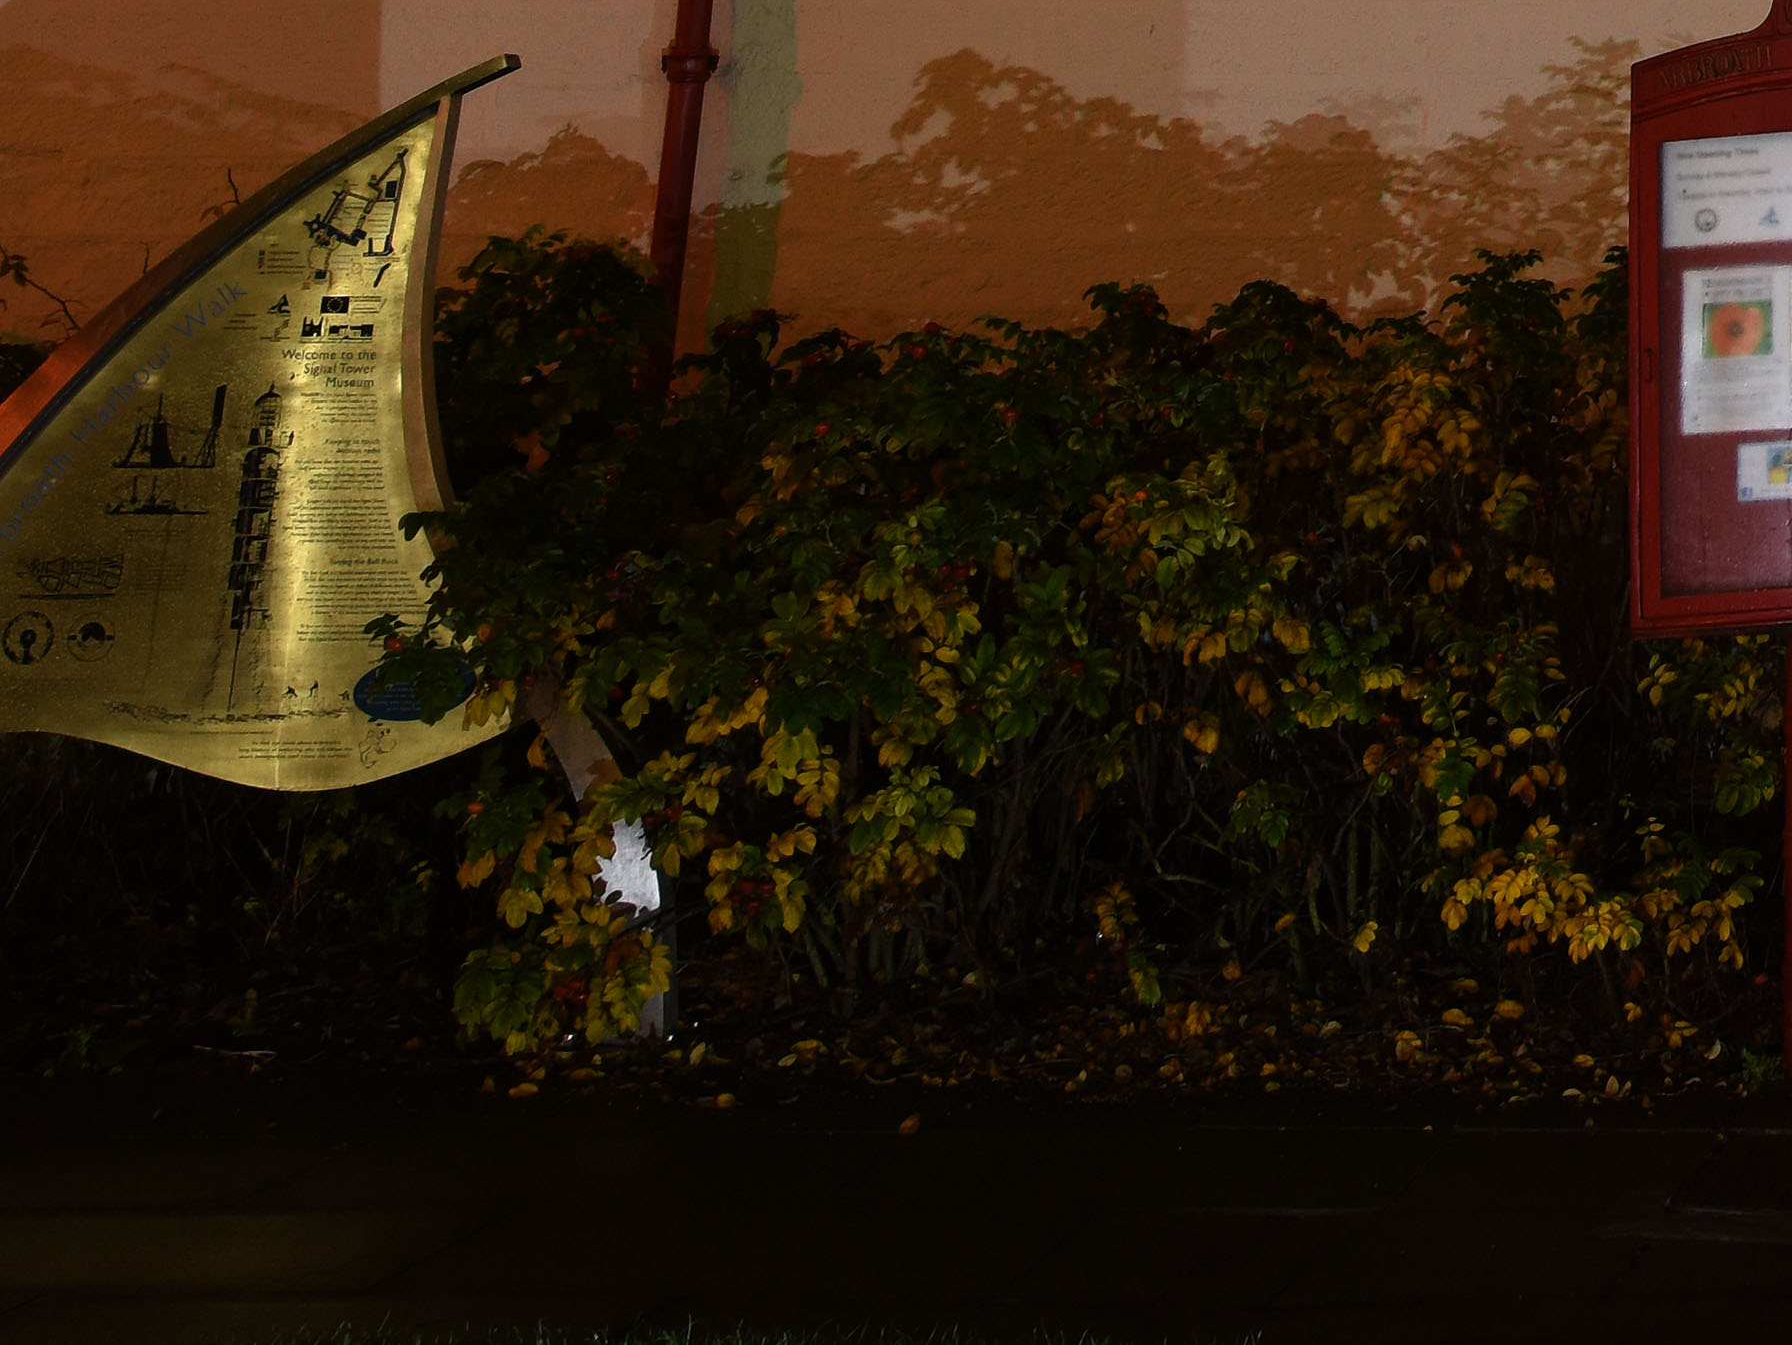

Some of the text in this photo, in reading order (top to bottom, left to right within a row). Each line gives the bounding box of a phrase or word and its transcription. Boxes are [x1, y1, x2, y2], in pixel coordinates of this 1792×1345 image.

[1659, 44, 1774, 90] ARBROATH
[282, 349, 377, 360] Welcome to the
[71, 345, 175, 446] Harbour
[175, 282, 248, 338] Walk
[303, 362, 376, 378] Signal Tower
[325, 377, 375, 388] Museum
